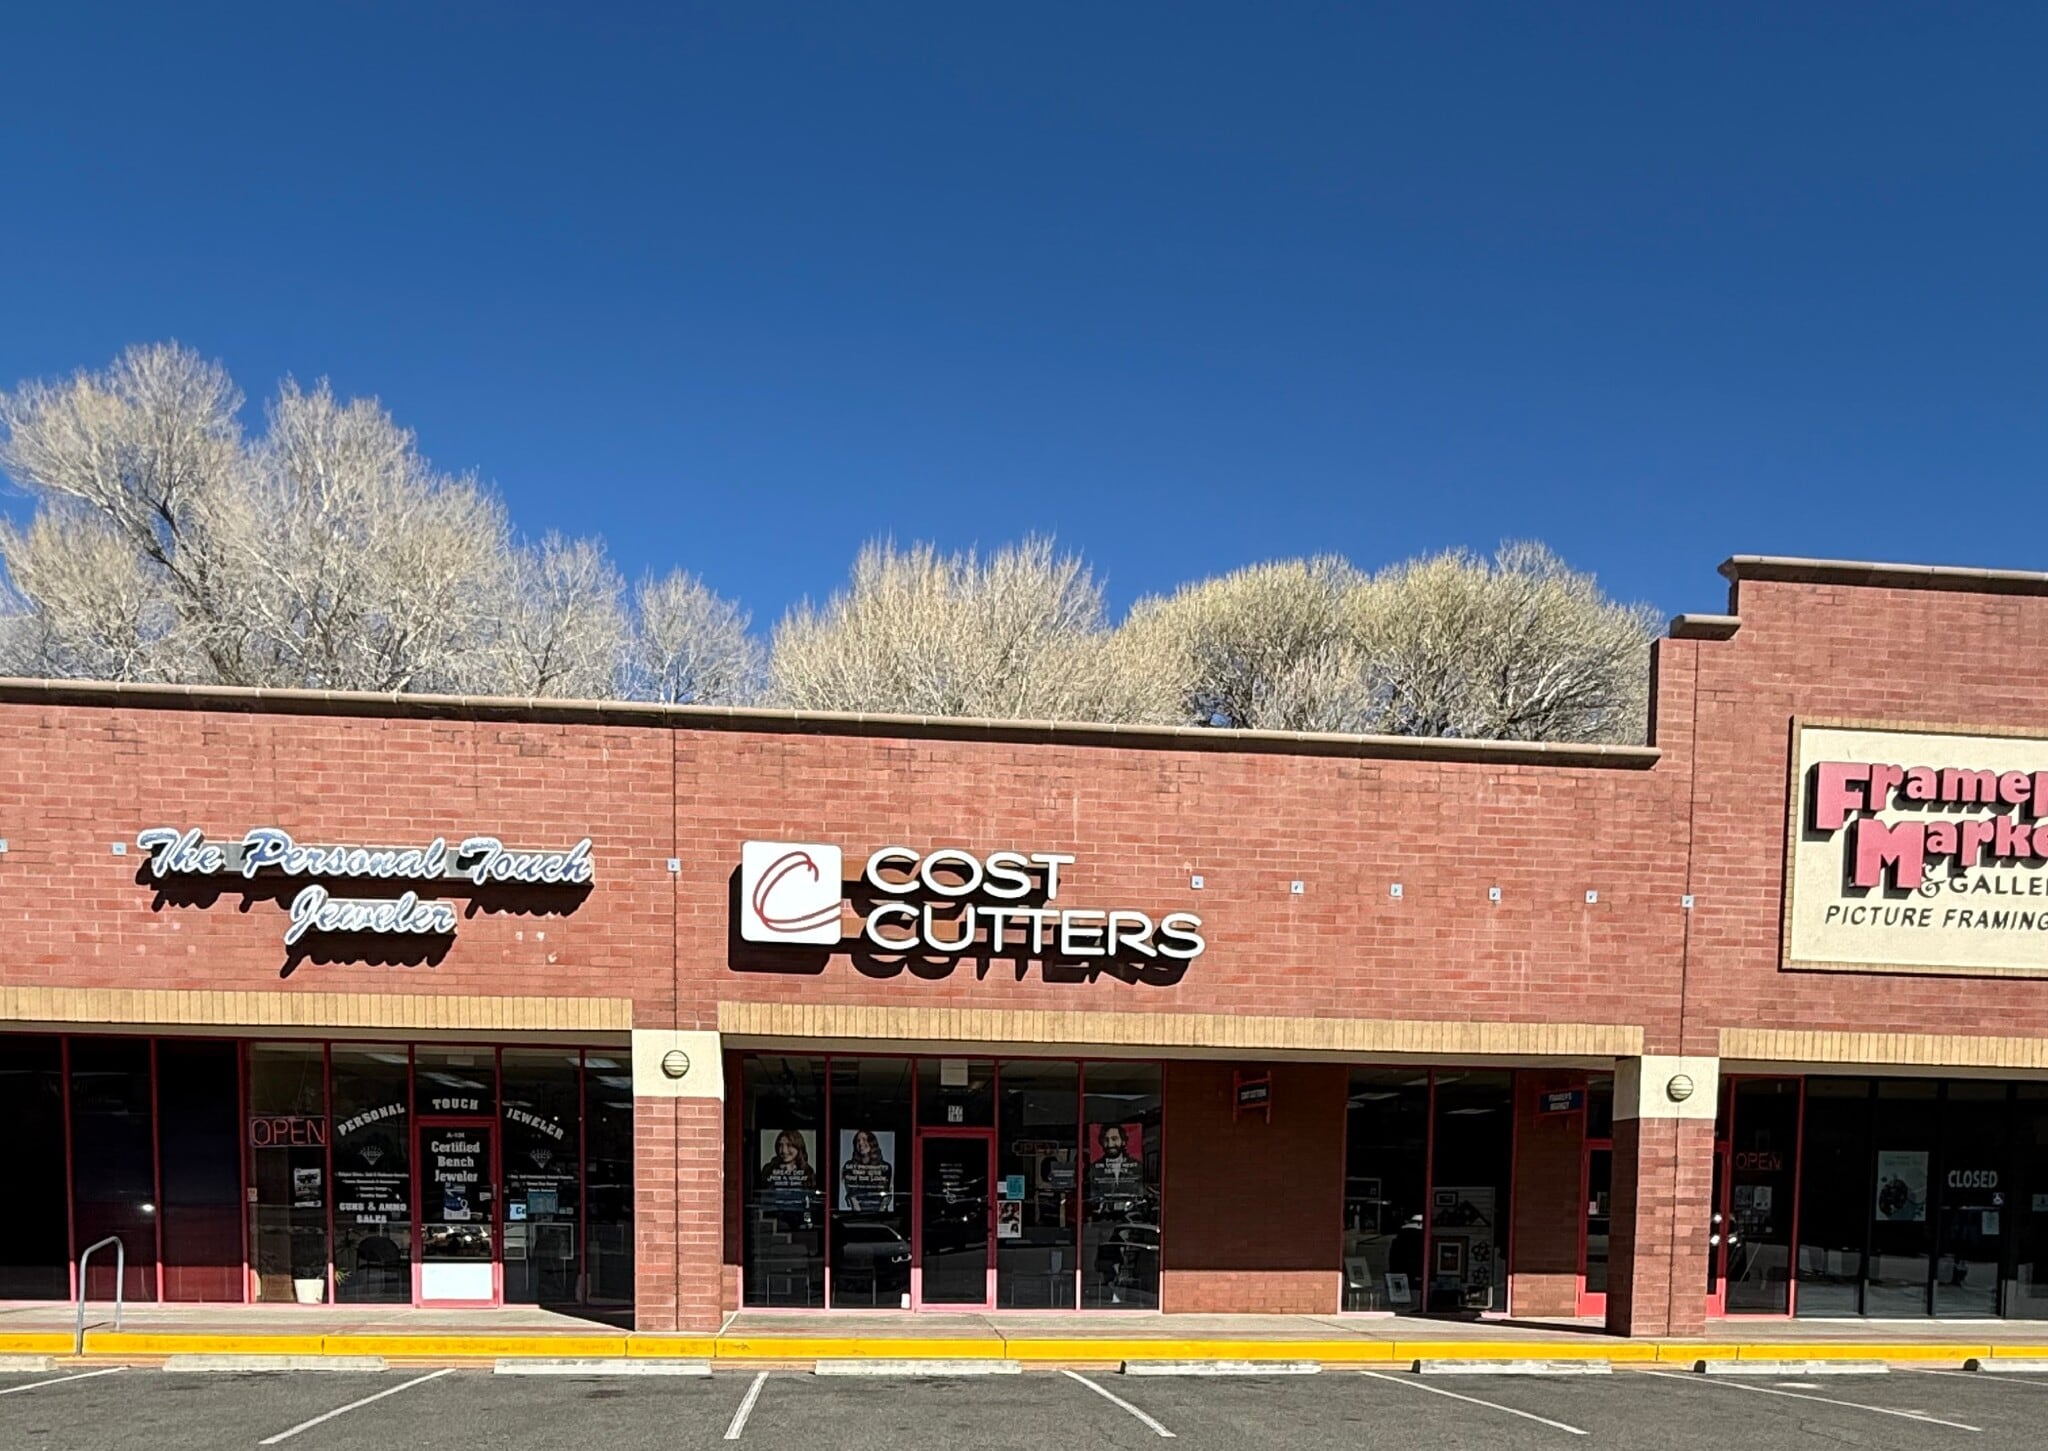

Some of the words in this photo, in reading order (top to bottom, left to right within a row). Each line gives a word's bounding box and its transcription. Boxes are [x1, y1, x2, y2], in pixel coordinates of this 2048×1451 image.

[137, 827, 224, 878] The
[241, 827, 446, 879] Personal
[461, 837, 593, 885] Touch
[866, 846, 1076, 900] COST
[1950, 874, 2048, 896] GALLE
[284, 884, 457, 945] Jeweler
[1825, 905, 1934, 928] PICTURE
[1943, 909, 2048, 931] FRAMING
[866, 904, 1206, 959] CUTTERS
[432, 1098, 479, 1110] TOUCH
[337, 1103, 405, 1136] PERSONAL
[506, 1108, 564, 1140] JEWELER
[251, 1118, 326, 1145] OPEN
[431, 1141, 481, 1153] Certified
[437, 1155, 475, 1167] Bench
[1735, 1152, 1781, 1171] OPEN
[434, 1169, 478, 1182] Jeweler
[1948, 1170, 1998, 1188] CLOSED
[367, 1201, 376, 1211] &
[356, 1214, 387, 1224] SALES
